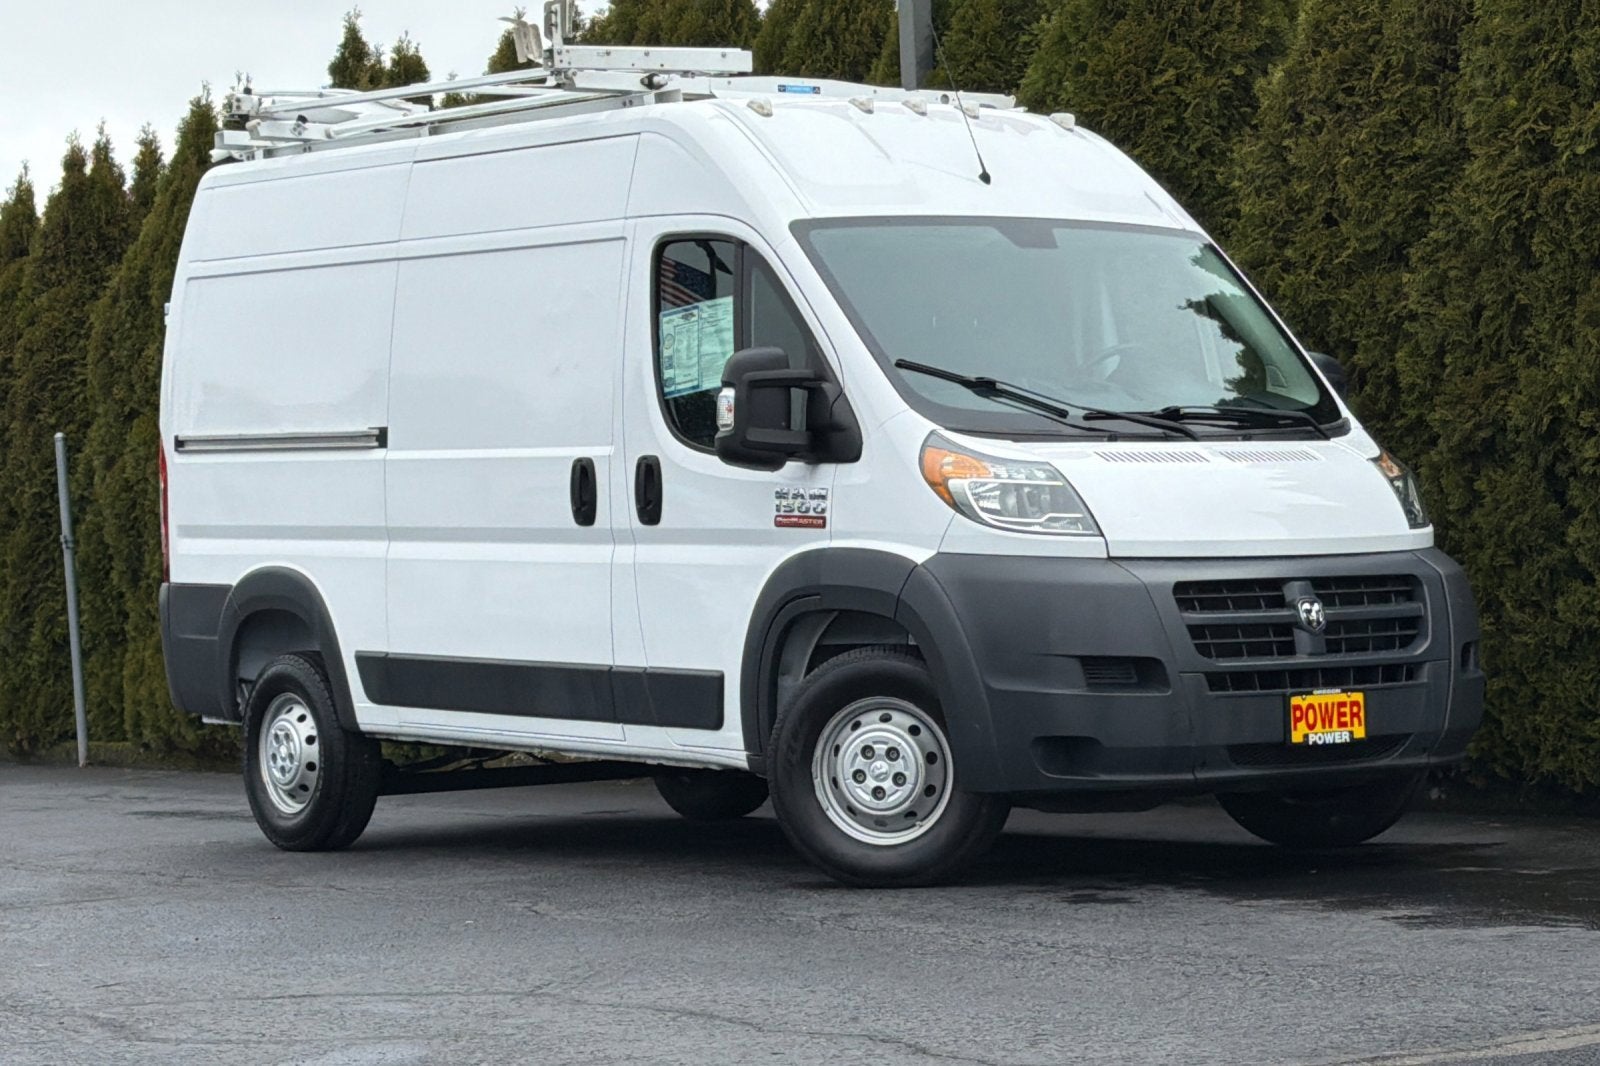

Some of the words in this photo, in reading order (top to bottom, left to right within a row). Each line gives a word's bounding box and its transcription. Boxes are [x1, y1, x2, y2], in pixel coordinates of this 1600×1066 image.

[775, 500, 827, 514] 1500
[776, 517, 823, 525] PASTER
[1292, 700, 1362, 731] POWER
[1308, 731, 1350, 745] POWER
